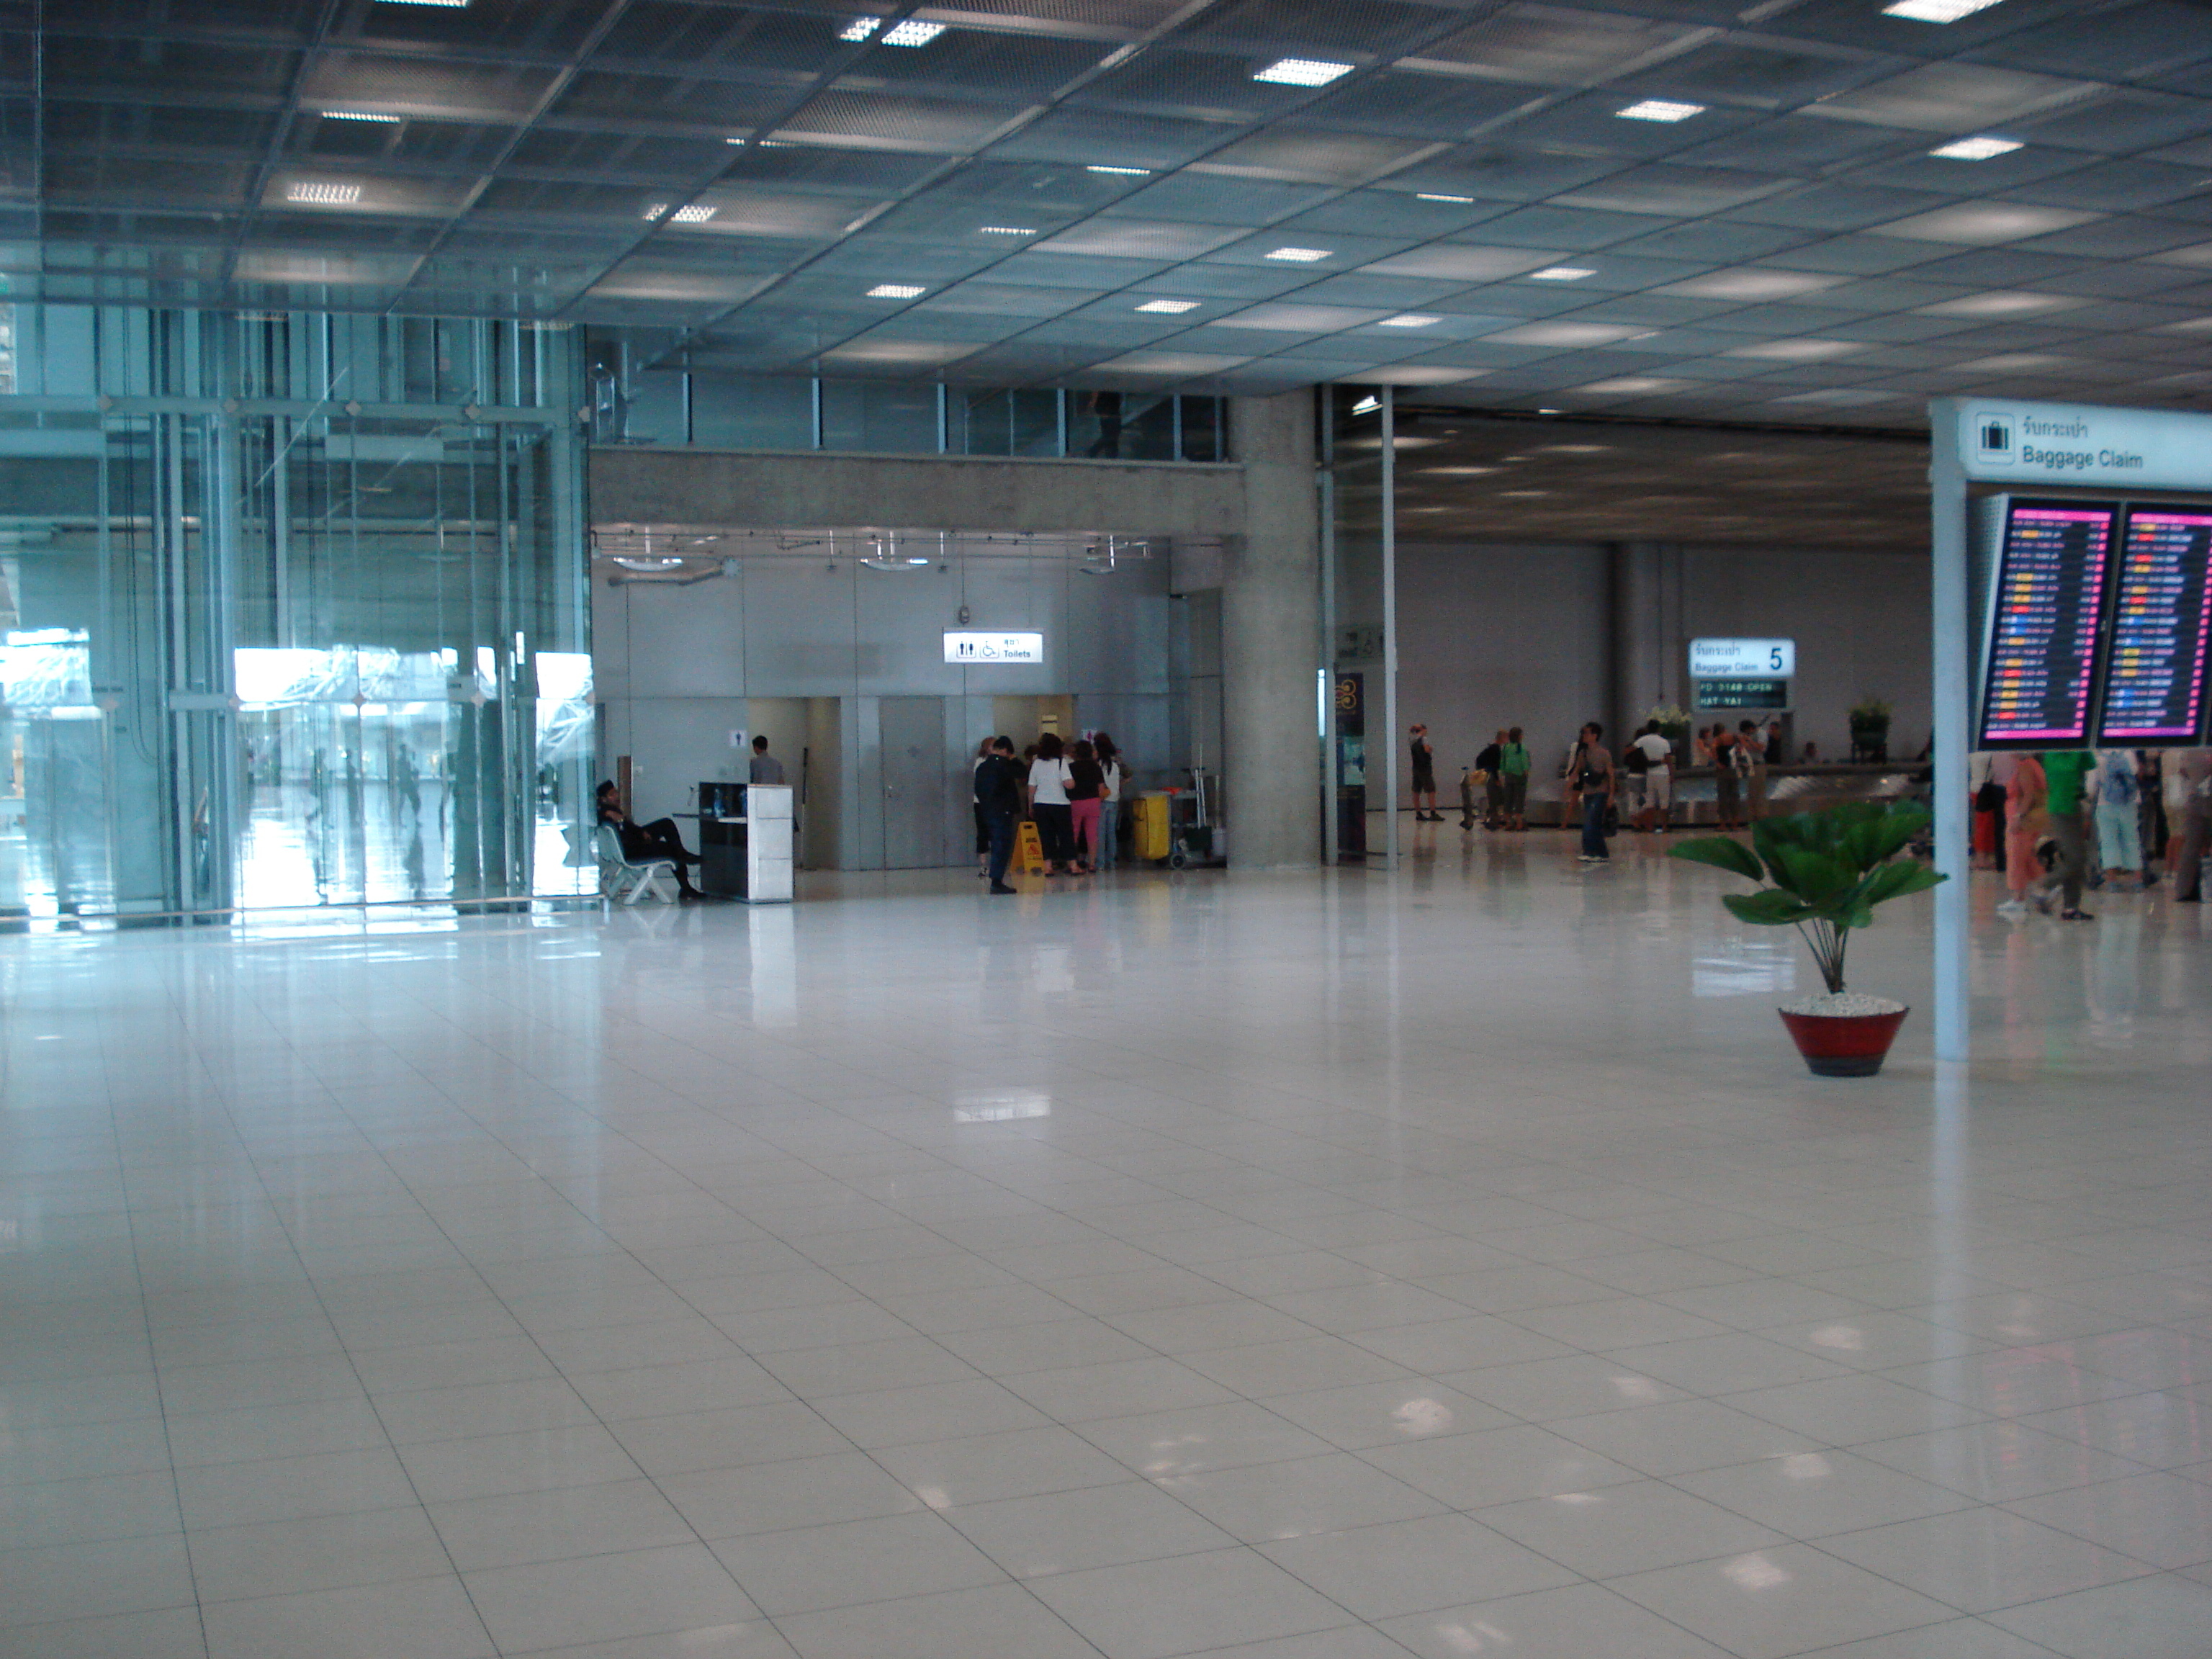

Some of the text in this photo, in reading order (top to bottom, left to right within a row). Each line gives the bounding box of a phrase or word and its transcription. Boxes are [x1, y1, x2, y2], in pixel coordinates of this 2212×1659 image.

[2023, 444, 2144, 469] Baggage Claim
[1695, 662, 1758, 673] Baggage Claim
[1770, 647, 1783, 670] 5
